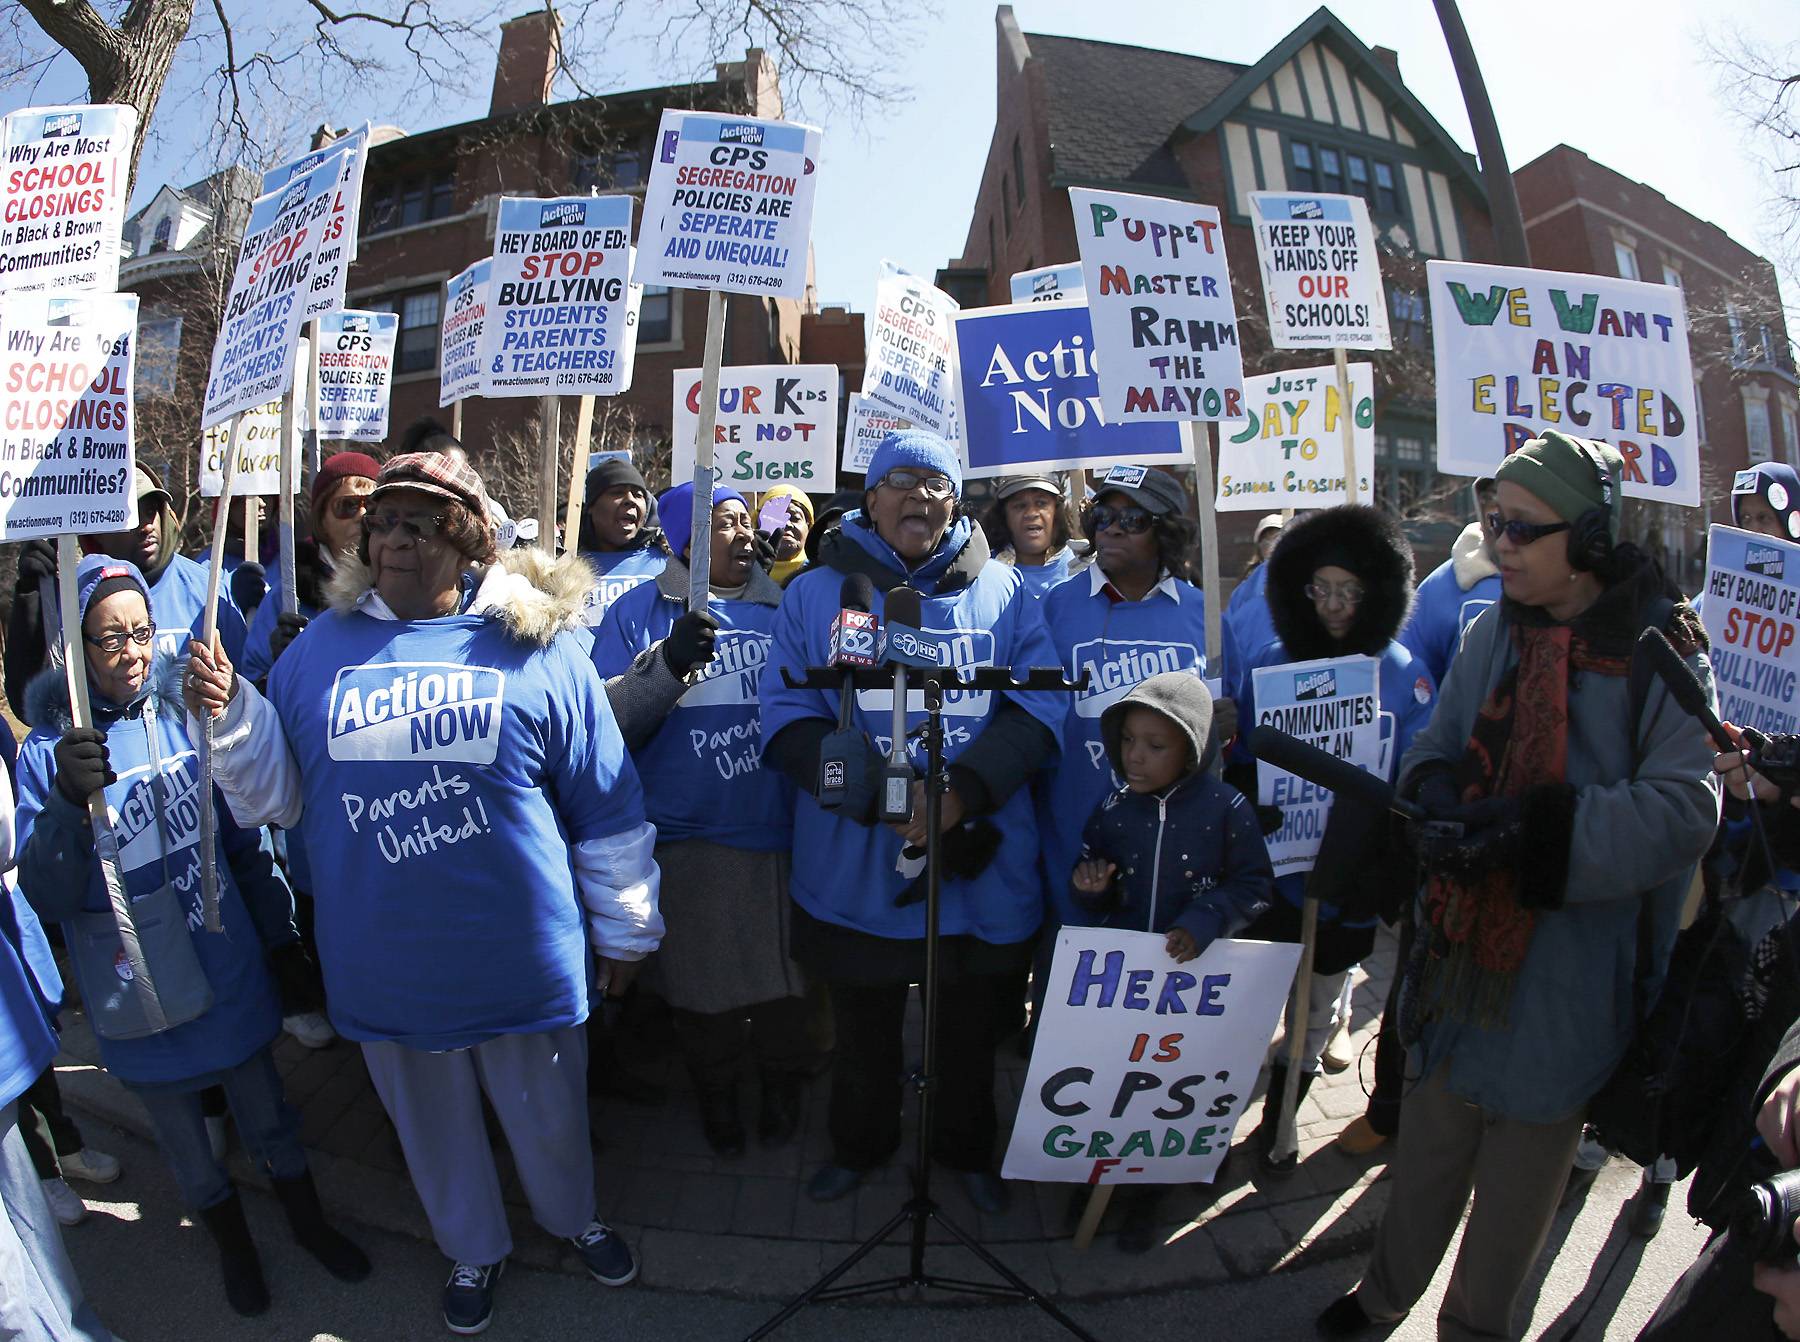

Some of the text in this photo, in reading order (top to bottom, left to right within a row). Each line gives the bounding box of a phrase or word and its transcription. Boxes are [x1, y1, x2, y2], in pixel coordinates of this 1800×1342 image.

[44, 114, 77, 134] Action
[61, 122, 80, 136] NOW
[720, 124, 758, 140] Action
[9, 137, 110, 164] Why Are Most
[740, 133, 763, 144] NOW
[709, 146, 769, 171] CPS
[7, 162, 105, 194] SCHOOL
[676, 166, 798, 196] SEGREGATION
[5, 189, 104, 223] CLOSINGS
[541, 203, 579, 223] Action
[672, 189, 793, 218] POLICIES ARE
[241, 229, 267, 263] HEY
[296, 201, 314, 229] OF
[311, 192, 331, 222] ED:
[561, 211, 585, 226] NOW
[679, 212, 779, 241] SEPERATE
[1090, 203, 1218, 258] PUPPET
[1, 220, 102, 246] In Black & Brown
[499, 229, 627, 254] HEY BOARD OF ED:
[1269, 225, 1357, 248] KEEP YOUR
[0, 241, 100, 274] Communities?
[249, 228, 308, 285] STOP
[520, 252, 604, 280] STOP
[664, 237, 789, 268] AND UNEQUAL!
[1274, 250, 1358, 272] HANDS OFF
[227, 252, 312, 321] BULLYING
[498, 278, 623, 306] BULLYING
[662, 270, 783, 288] www.actionnow.org (312) 676-4280
[1100, 265, 1219, 298] MASTER
[1298, 275, 1349, 298] OUR
[454, 289, 475, 312] CPS
[900, 296, 935, 326] CPS
[1445, 281, 1673, 342] WE WANT
[226, 290, 295, 345] STUDENTS
[444, 302, 486, 336] SEGREGATION
[504, 306, 609, 329] STUDENTS
[1286, 304, 1369, 327] SCHOOLS!
[337, 334, 372, 351] CPS
[443, 321, 484, 351] POLICIES ARE
[502, 328, 607, 351] PARENTS
[878, 304, 950, 355] SEGREGATION
[8, 330, 81, 357] Why Are
[220, 318, 288, 372] PARENTS
[444, 341, 476, 368] SEPERATE
[875, 324, 947, 374] POLICIES ARE
[208, 344, 288, 401] & TEACHERS!
[320, 353, 388, 369] SEGREGATION
[451, 358, 481, 383] UNEQUAL!
[491, 350, 616, 373] & TEACHERS!
[879, 346, 940, 389] SEPERATE
[1150, 355, 1206, 380] THE
[1532, 338, 1591, 380] AN
[6, 362, 125, 396] SCHOOL
[366, 372, 386, 385] ARE
[492, 372, 613, 387] www.actionnow.org (312) 676-4280
[869, 367, 892, 388] AND
[894, 375, 945, 414] UNEQUAL!
[1267, 376, 1317, 395] JUST
[320, 387, 378, 402] SEPERATE
[1124, 386, 1243, 417] MAYOR
[1472, 374, 1685, 437] ELECTED
[5, 399, 126, 431] CLOSINGS
[320, 407, 383, 422] ND UNEQUAL!
[206, 425, 229, 452] fo
[756, 423, 816, 442] NOT
[3, 436, 126, 461] In Black & Brown
[1281, 437, 1318, 461] TO
[732, 451, 814, 481] SIGNS
[0, 468, 128, 498] Communities?
[1222, 475, 1276, 497] SCHOOL
[70, 510, 125, 527] (312) 676-4280
[1746, 549, 1780, 565] Action
[1709, 570, 1736, 596] HEY
[1736, 576, 1777, 612] BOARD
[1779, 589, 1793, 615] OF
[846, 613, 874, 630] FOX
[1724, 607, 1795, 658] STOP
[842, 629, 874, 655] 32
[919, 645, 937, 656] HD
[842, 654, 873, 665] NEWS
[1296, 671, 1330, 696] Action
[1316, 680, 1336, 698] NOW
[1712, 648, 1797, 703] BULLYING
[335, 670, 473, 736] Action
[410, 703, 493, 754] NOW
[1335, 731, 1353, 759] AN
[342, 764, 471, 833] Parents
[377, 796, 491, 864] United!
[1066, 950, 1231, 1016] HERE
[1128, 1033, 1184, 1063] IS
[1043, 1124, 1230, 1158] GRADE:
